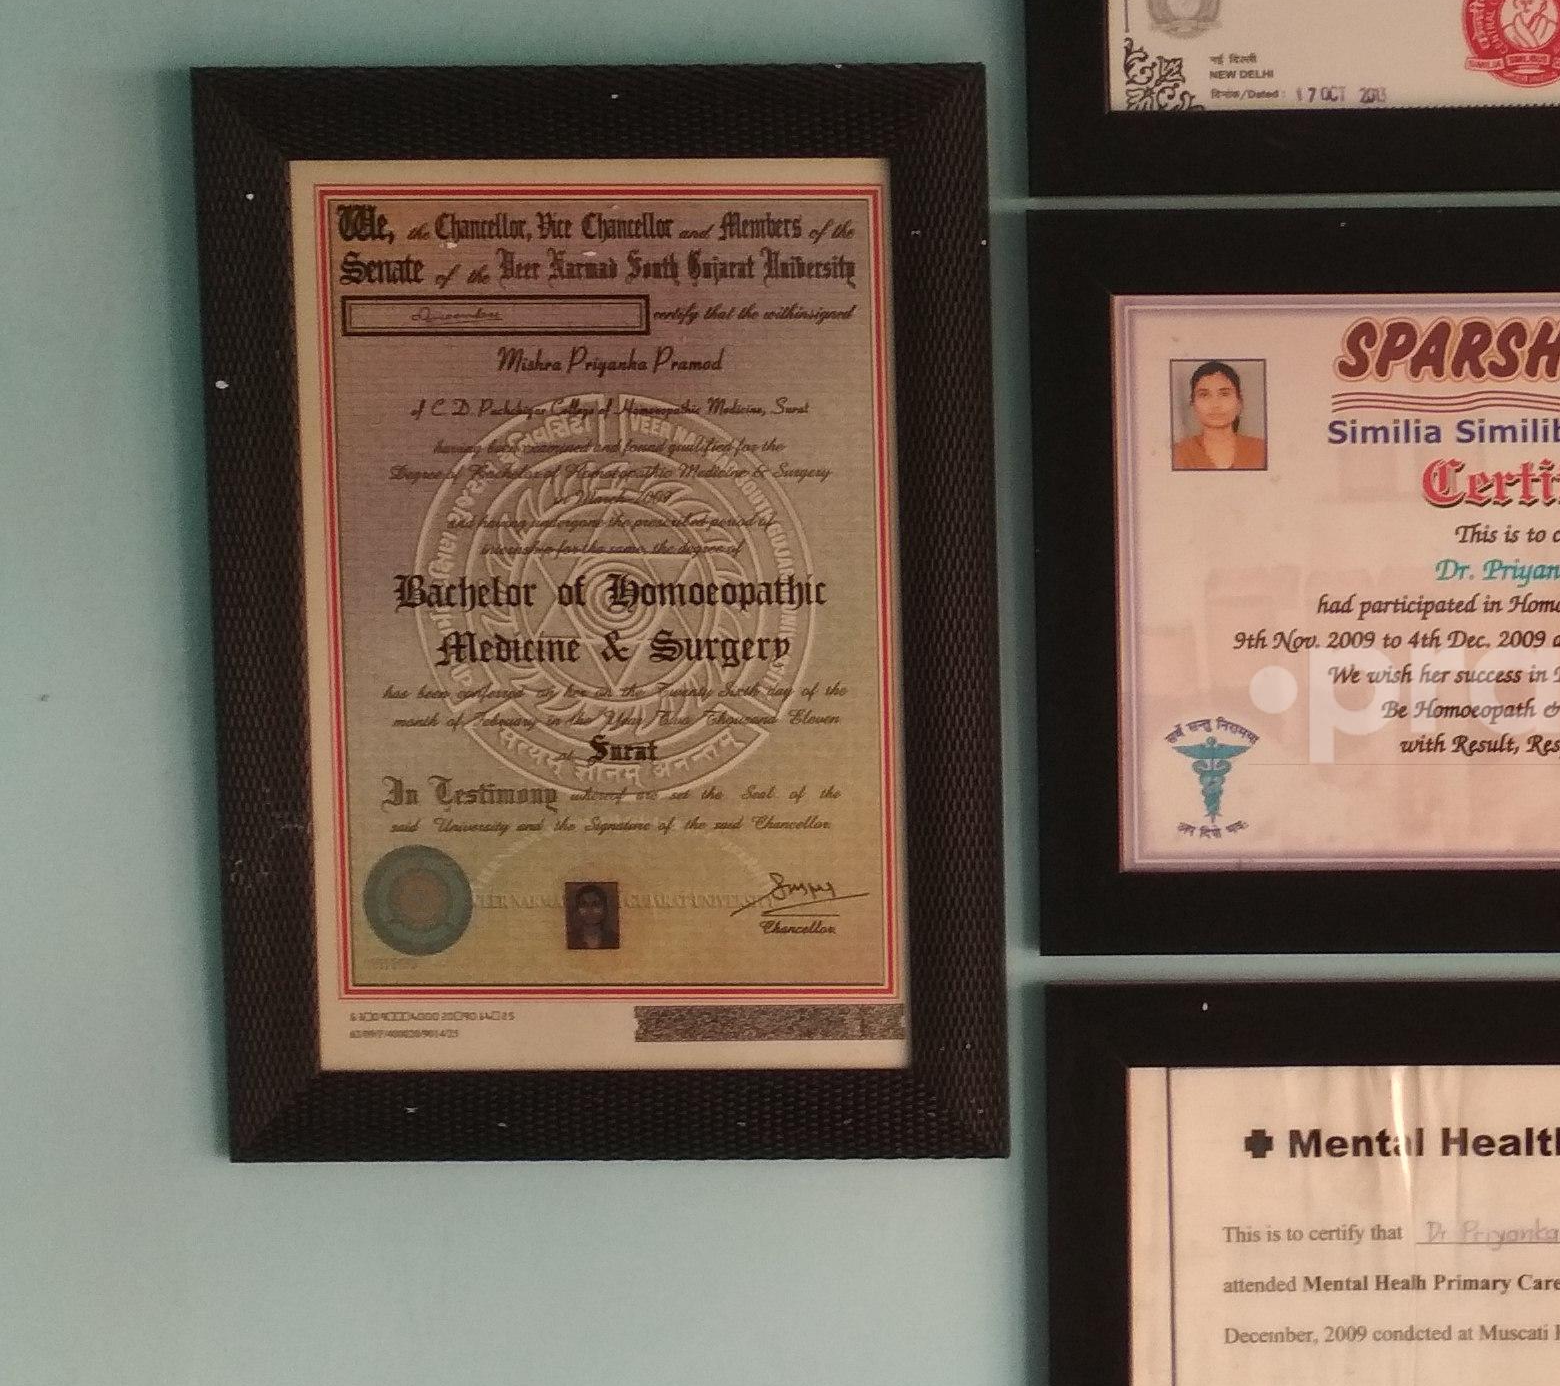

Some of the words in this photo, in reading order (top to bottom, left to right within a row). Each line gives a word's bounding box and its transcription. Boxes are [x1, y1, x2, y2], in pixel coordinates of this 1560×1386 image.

[1209, 69, 1237, 80] NEW
[1239, 70, 1274, 79] DELHI
[497, 345, 562, 373] Mishra
[566, 346, 648, 377] Priyanka
[652, 345, 726, 373] Pramod
[1327, 419, 1442, 444] Similia
[1455, 523, 1498, 543] This
[1504, 525, 1520, 544] is
[1526, 528, 1547, 543] to
[1435, 559, 1474, 581] Dr.
[394, 574, 537, 610] Bachelor
[557, 574, 587, 607] of
[608, 573, 828, 610] Homoeopathic
[1317, 593, 1357, 614] had
[1358, 594, 1480, 620] participated
[1483, 595, 1503, 613] in
[435, 631, 581, 667] Medicine
[600, 631, 632, 662] &
[648, 629, 791, 667] Surgery
[1233, 629, 1268, 649] 9th
[1272, 628, 1320, 653] Nov.
[1326, 631, 1376, 649] 2009
[1382, 634, 1402, 649] to
[1407, 628, 1442, 649] 4th
[1447, 630, 1491, 649] Dec.
[1496, 630, 1546, 649] 2009
[588, 734, 660, 765] Surat
[1400, 732, 1446, 753] with
[1451, 733, 1519, 757] Result,
[380, 776, 420, 810] In
[429, 776, 560, 810] Testimony
[1289, 1127, 1424, 1158] Mental
[1222, 1226, 1261, 1243] This
[1266, 1225, 1281, 1242] is
[1286, 1228, 1304, 1241] to
[1308, 1224, 1365, 1245] certify
[1370, 1223, 1404, 1241] that
[1223, 1276, 1296, 1293] attended
[1303, 1275, 1368, 1292] Mental
[1375, 1274, 1426, 1291] Healh
[1434, 1274, 1511, 1294] Primary
[1224, 1327, 1318, 1344] December,
[1324, 1325, 1368, 1343] 2009
[1372, 1325, 1452, 1342] condcted
[1458, 1327, 1473, 1341] at
[1479, 1324, 1548, 1341] Muscati
